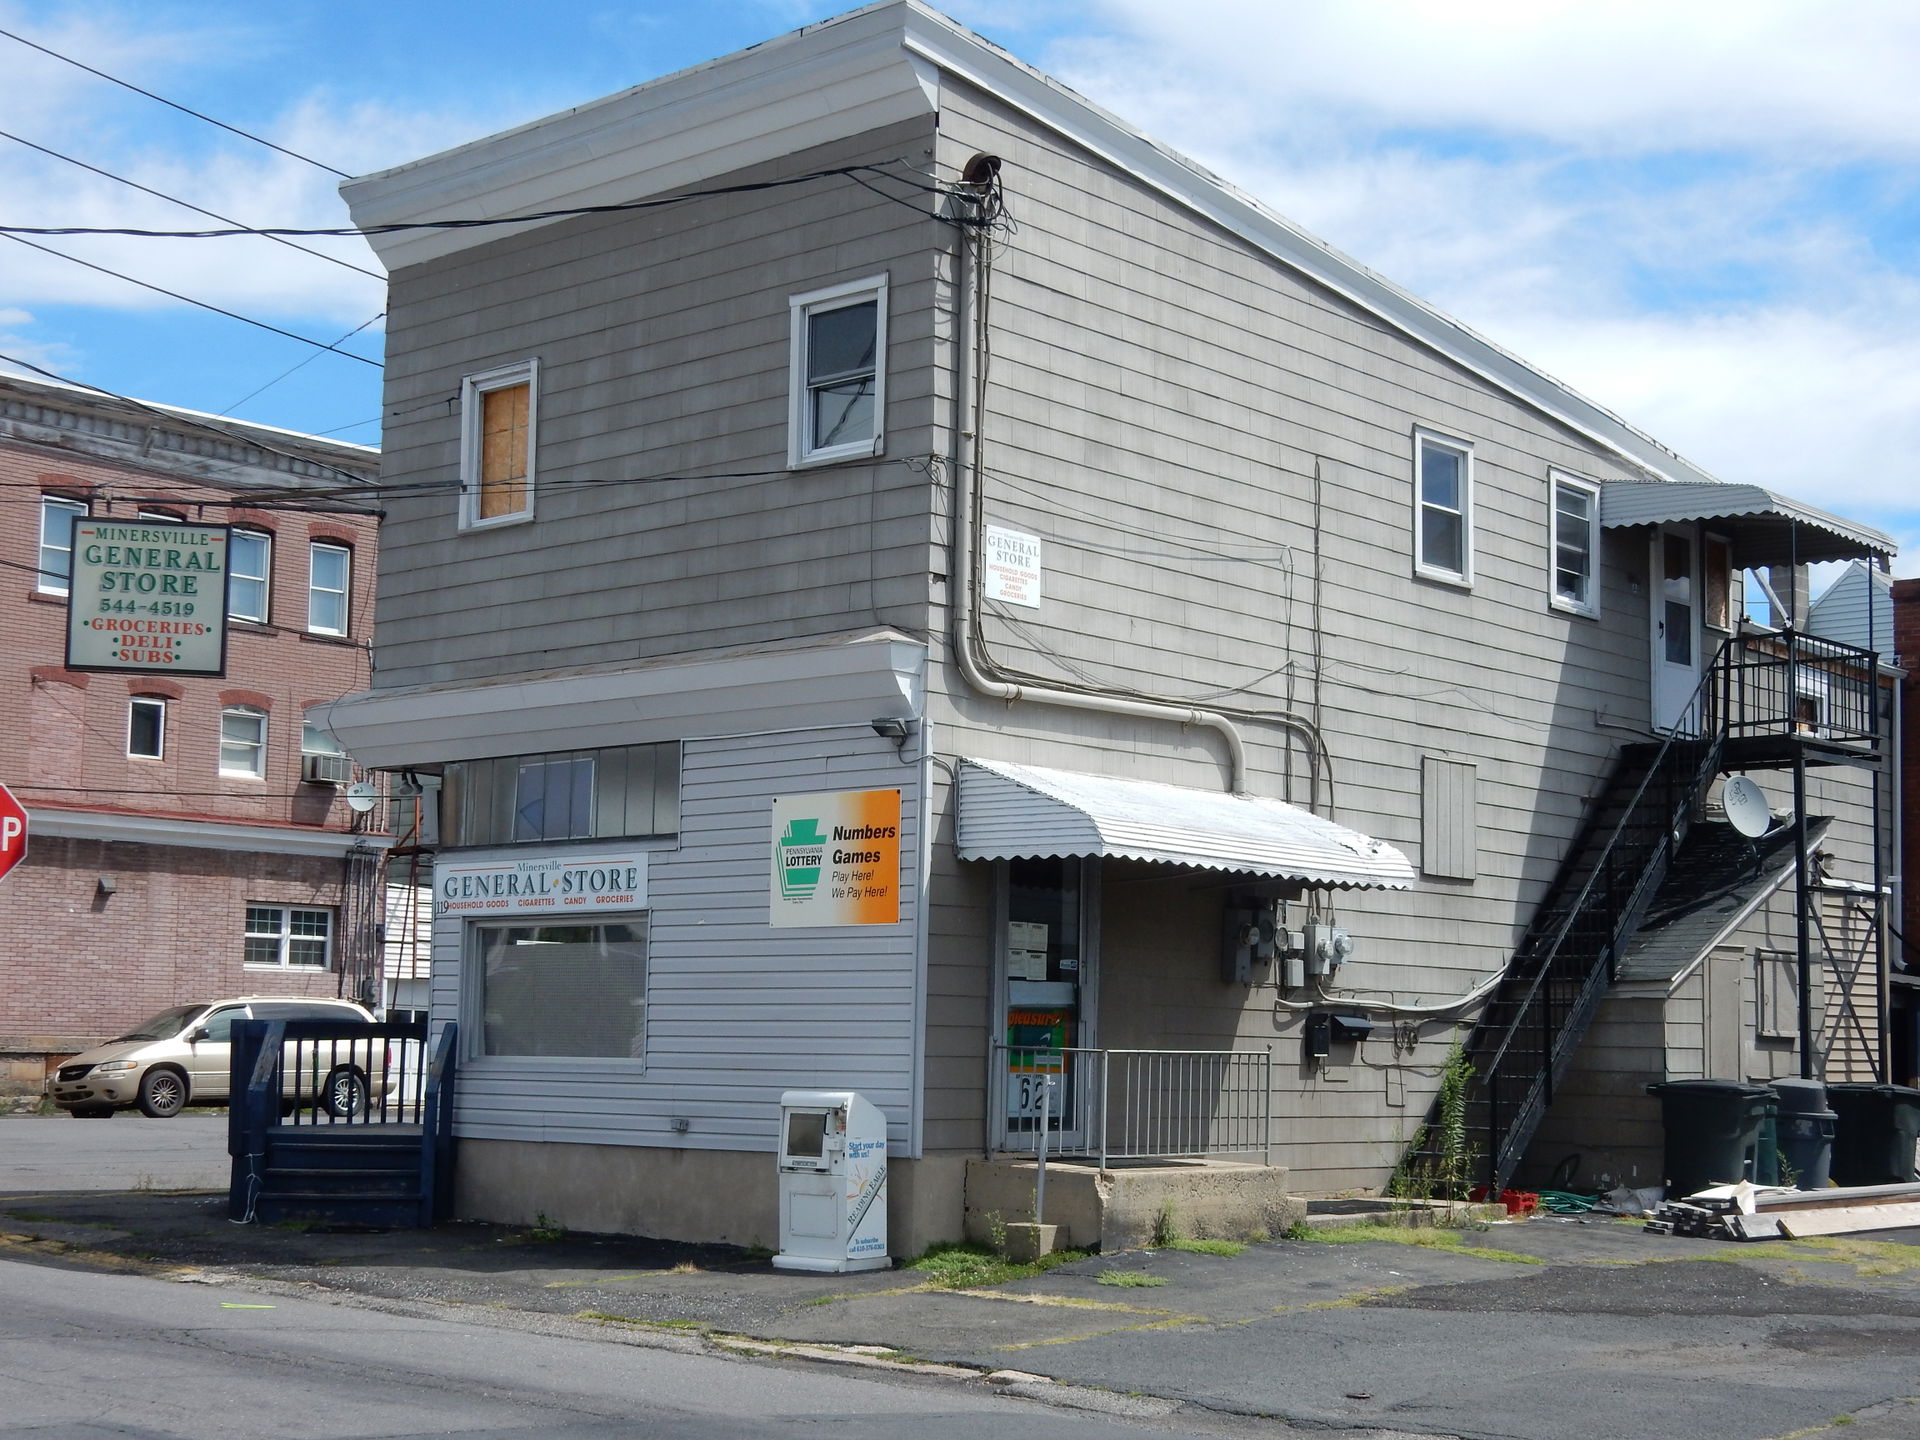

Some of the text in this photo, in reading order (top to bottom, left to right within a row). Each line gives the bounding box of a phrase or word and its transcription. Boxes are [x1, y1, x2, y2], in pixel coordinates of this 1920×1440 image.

[95, 527, 209, 546] MINERSVILLE
[988, 535, 1040, 558] GENERAL
[84, 545, 221, 572] GENERAL
[996, 550, 1031, 568] STORE
[101, 571, 199, 595] STORE
[99, 598, 195, 617] 544-4519
[91, 617, 205, 635] GROCERIES
[121, 634, 173, 649] DELI
[119, 649, 174, 664] SUBS
[832, 824, 896, 841] Numbers
[786, 847, 823, 855] PENNSYLVANIA
[832, 849, 881, 865] Games
[516, 860, 562, 873] Minersville
[786, 855, 822, 867] LOTTERY
[444, 867, 639, 899] GENERAL STORE
[831, 869, 874, 884] Play Here!
[831, 886, 888, 900] We Pay Here!
[436, 900, 449, 915] 119
[448, 894, 634, 910] HOUSEHOLD GOODS CIGARETTES CANDY GROCERIES
[847, 1164, 886, 1225] READING EAGLE
